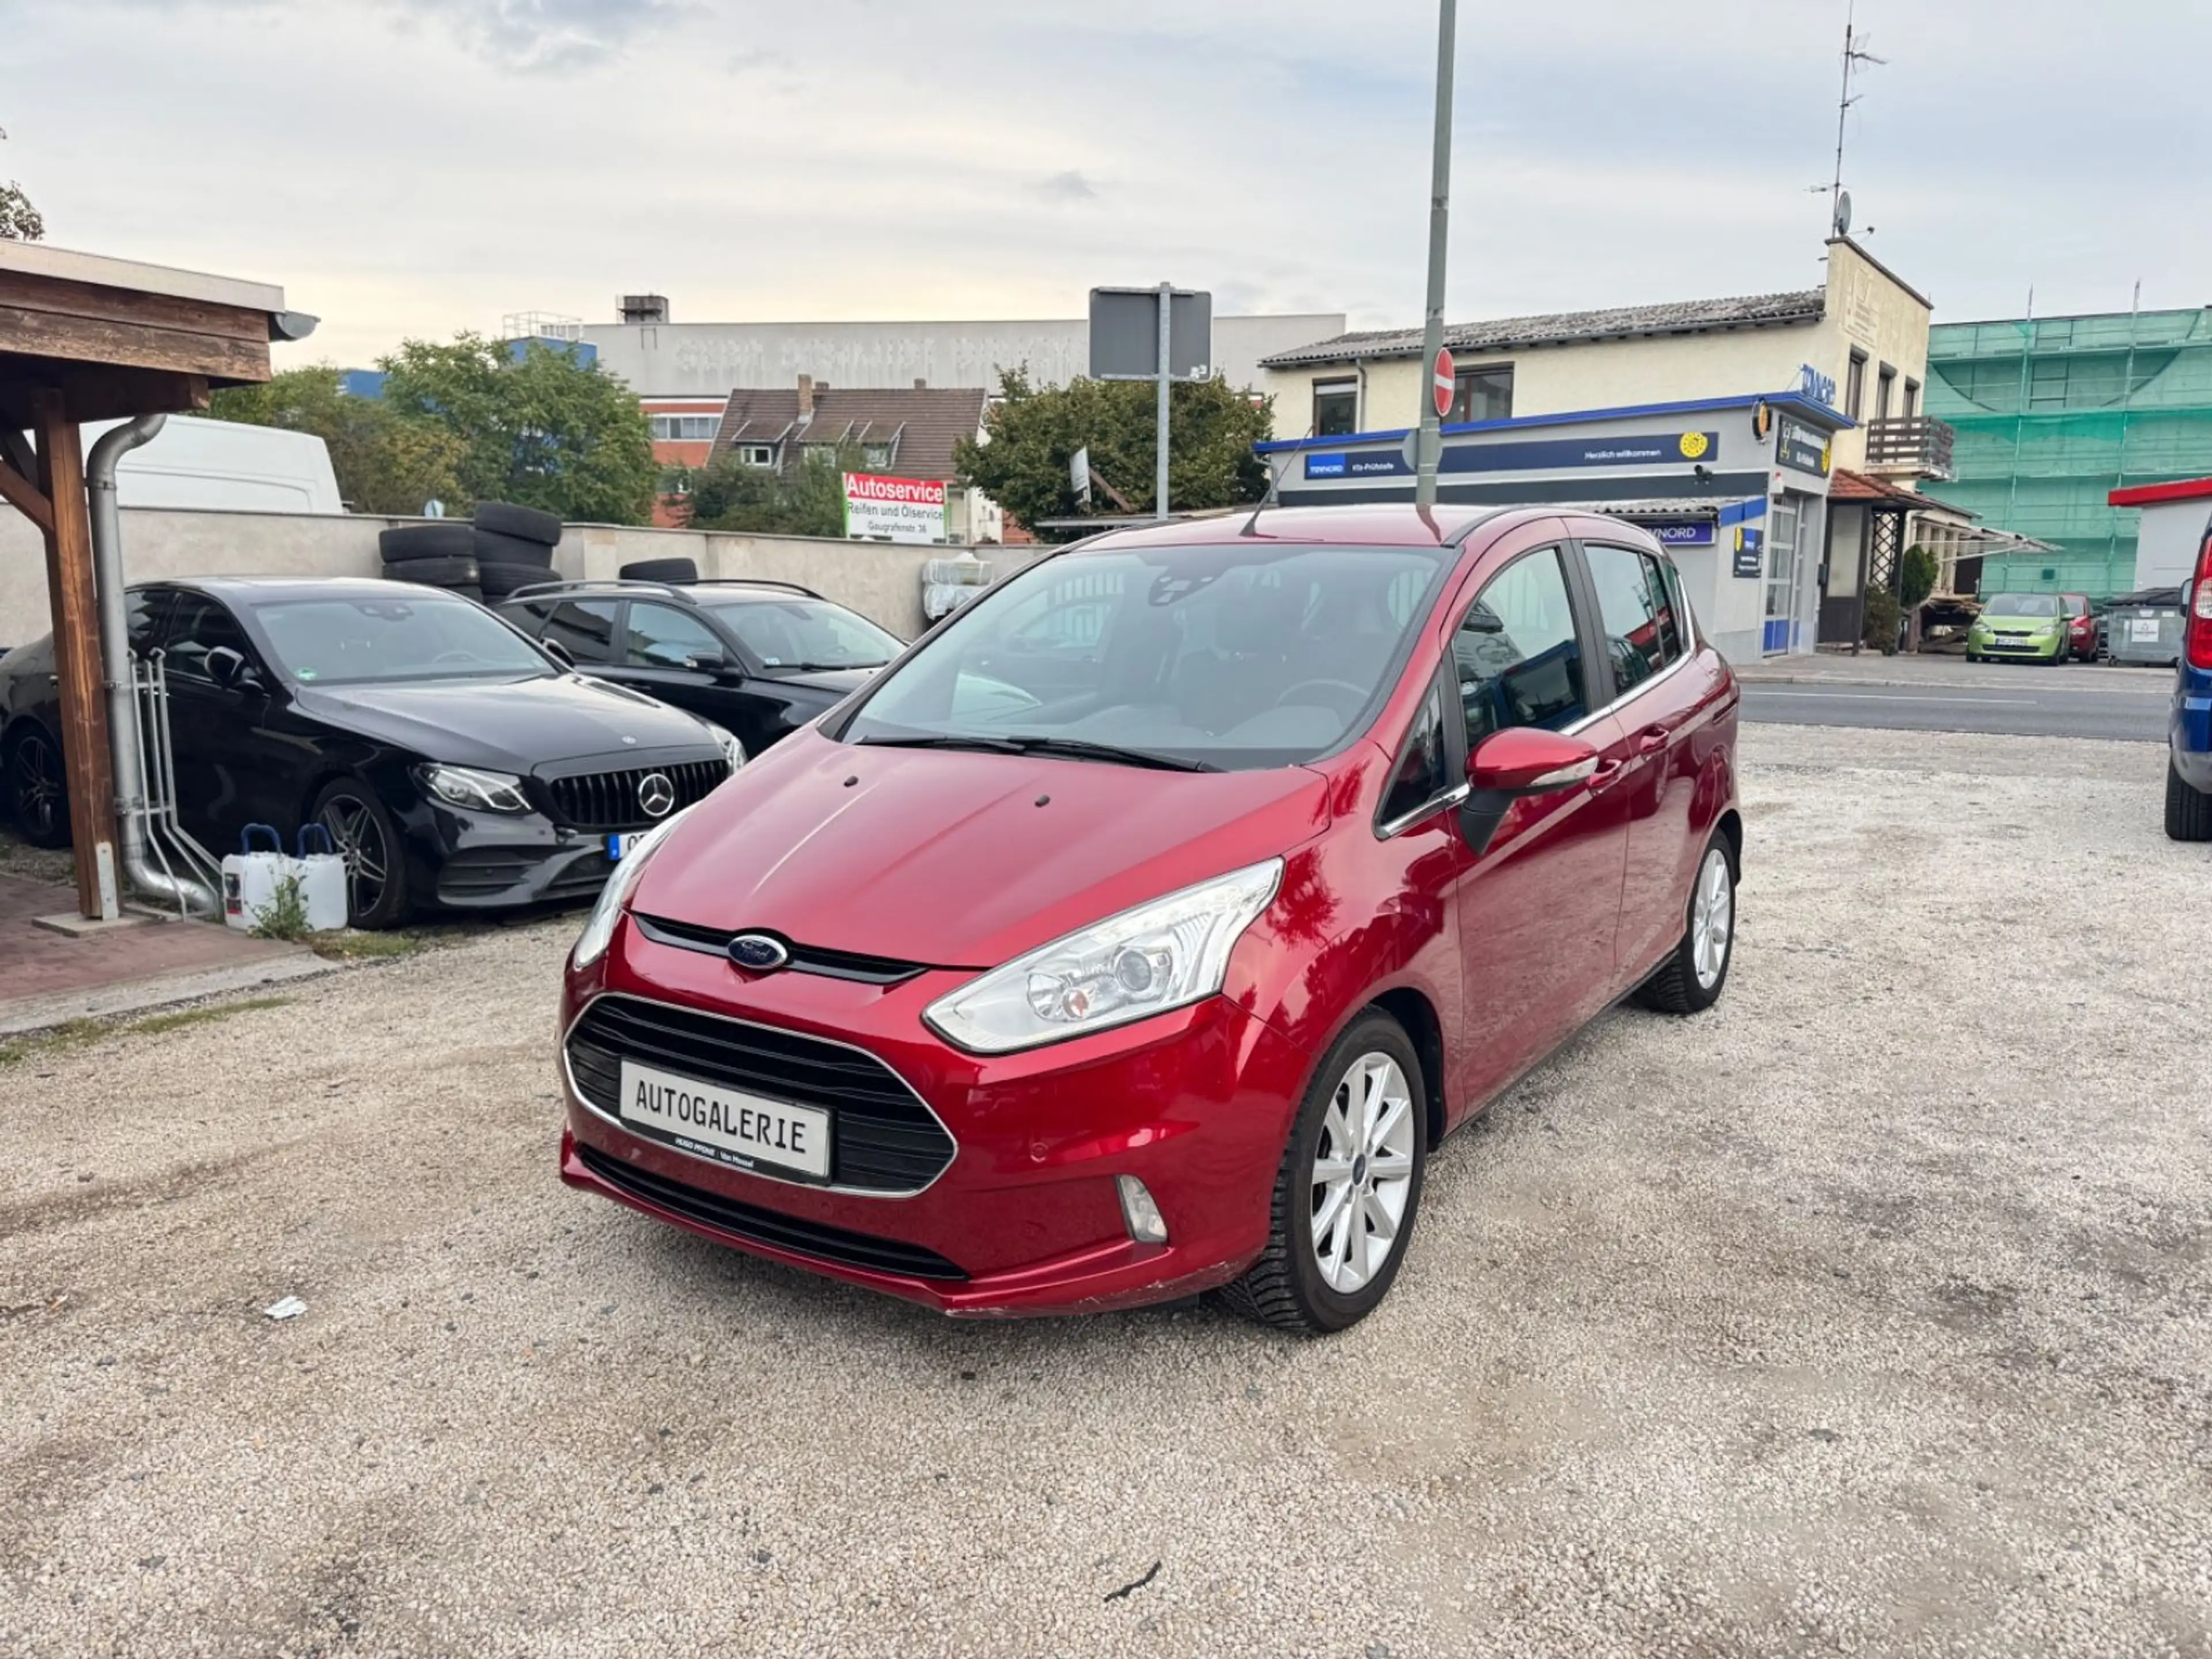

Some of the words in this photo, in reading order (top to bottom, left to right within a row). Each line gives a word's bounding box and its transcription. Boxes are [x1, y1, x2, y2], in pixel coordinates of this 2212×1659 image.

[848, 475, 943, 502] Autoservice
[849, 502, 878, 516] Reifen
[881, 506, 899, 517] und
[901, 503, 944, 521] Ölservice
[636, 1080, 806, 1154] AUTOGALERIE
